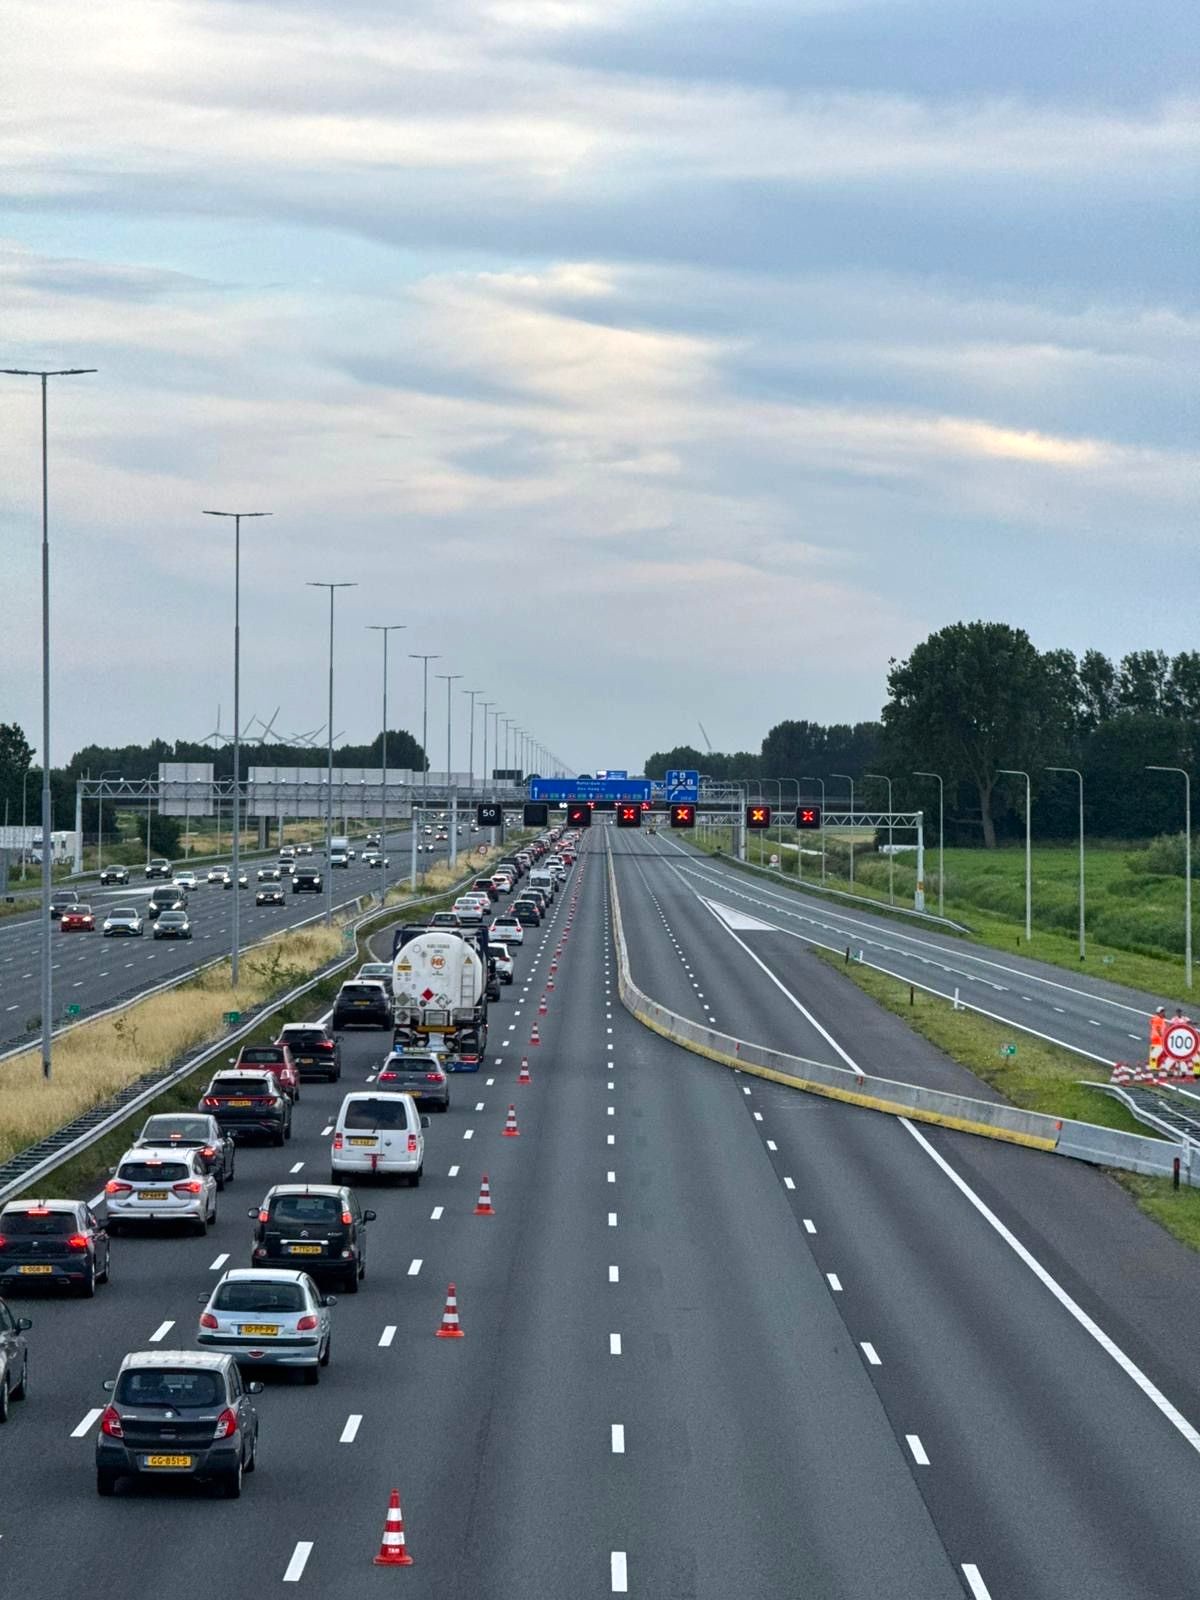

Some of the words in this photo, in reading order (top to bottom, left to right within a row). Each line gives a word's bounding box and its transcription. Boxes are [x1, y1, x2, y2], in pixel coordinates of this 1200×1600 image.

[482, 809, 495, 817] 50
[1170, 1035, 1193, 1050] 100
[151, 1456, 188, 1465] GG-851-S
